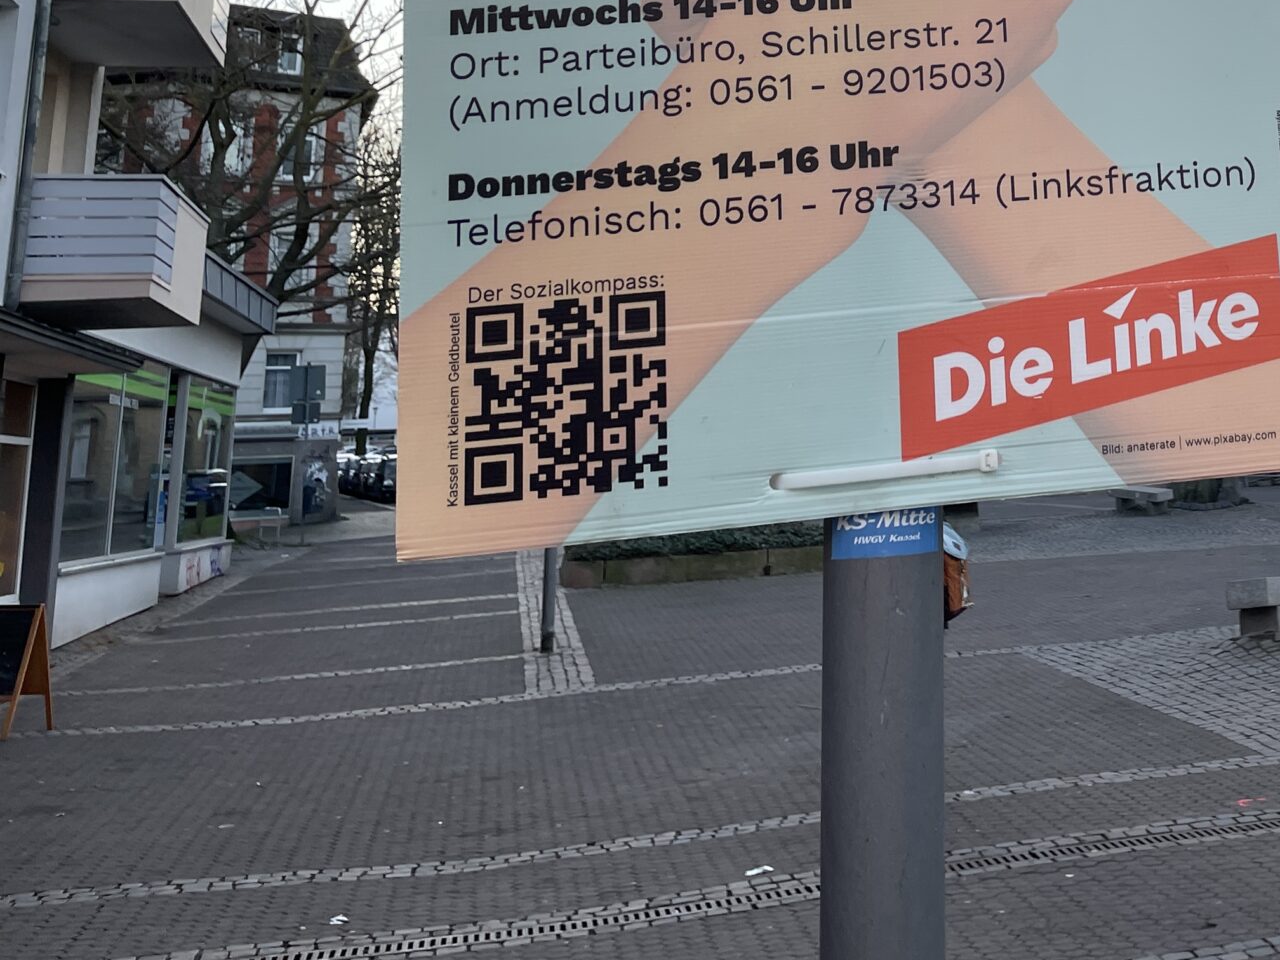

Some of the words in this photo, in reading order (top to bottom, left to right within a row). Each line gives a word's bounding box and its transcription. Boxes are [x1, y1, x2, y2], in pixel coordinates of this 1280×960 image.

[449, 50, 520, 80] Ort:
[537, 35, 745, 75] Parteibüro,
[760, 22, 960, 58] Schillerstr.
[975, 18, 1010, 44] 21
[449, 82, 692, 131] (Anmeldung:
[710, 75, 794, 107] 0561
[842, 57, 1006, 98] 9201503)
[447, 155, 701, 204] Donnerstags
[711, 146, 819, 181] 14-16
[828, 140, 899, 173] Uhr
[447, 201, 682, 248] Telefonisch:
[699, 192, 784, 228] 0561
[831, 180, 981, 217] 7873314
[995, 156, 1257, 209] (Linksfraktion)
[468, 287, 503, 304] Der
[510, 274, 665, 300] Sozialkompass:
[448, 312, 461, 383] Geldbeutel
[933, 337, 1054, 423] Die
[1068, 286, 1261, 385] Linke
[447, 385, 460, 441] kleinem
[447, 444, 459, 468] mit
[1101, 444, 1124, 455] Bild:
[1127, 440, 1176, 454] anaterate
[1185, 430, 1277, 448] www.pixabay.com
[447, 470, 459, 508] Kassel
[836, 510, 935, 531] KS-Mitte
[853, 534, 885, 545] HWGV
[889, 532, 921, 543] Kassel
